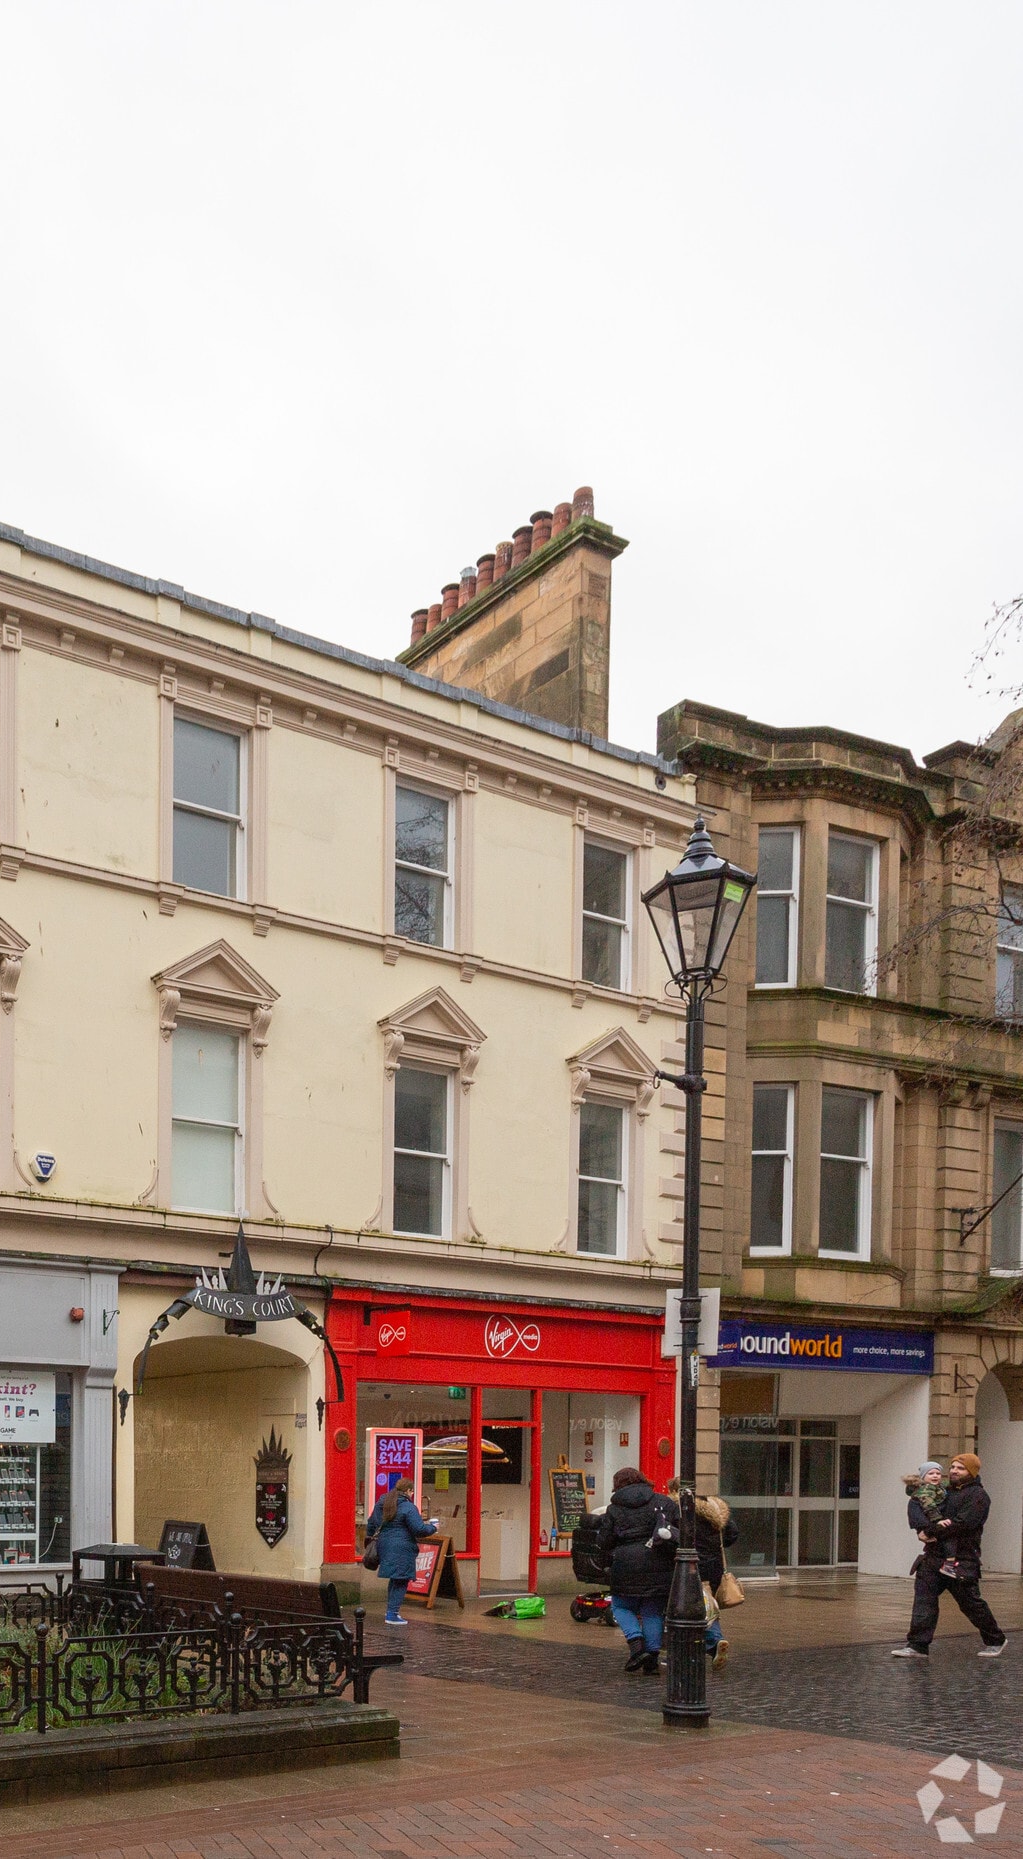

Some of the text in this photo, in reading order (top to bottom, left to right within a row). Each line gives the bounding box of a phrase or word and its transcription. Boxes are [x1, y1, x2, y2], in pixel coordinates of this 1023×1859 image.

[194, 1289, 295, 1316] KING'S COURT
[488, 1321, 514, 1351] Virgin
[740, 1332, 842, 1358] oundworld
[853, 1346, 868, 1354] more
[890, 1348, 905, 1356] more
[906, 1349, 925, 1359] savings
[379, 1438, 412, 1451] SAVE
[378, 1451, 412, 1465] £144
